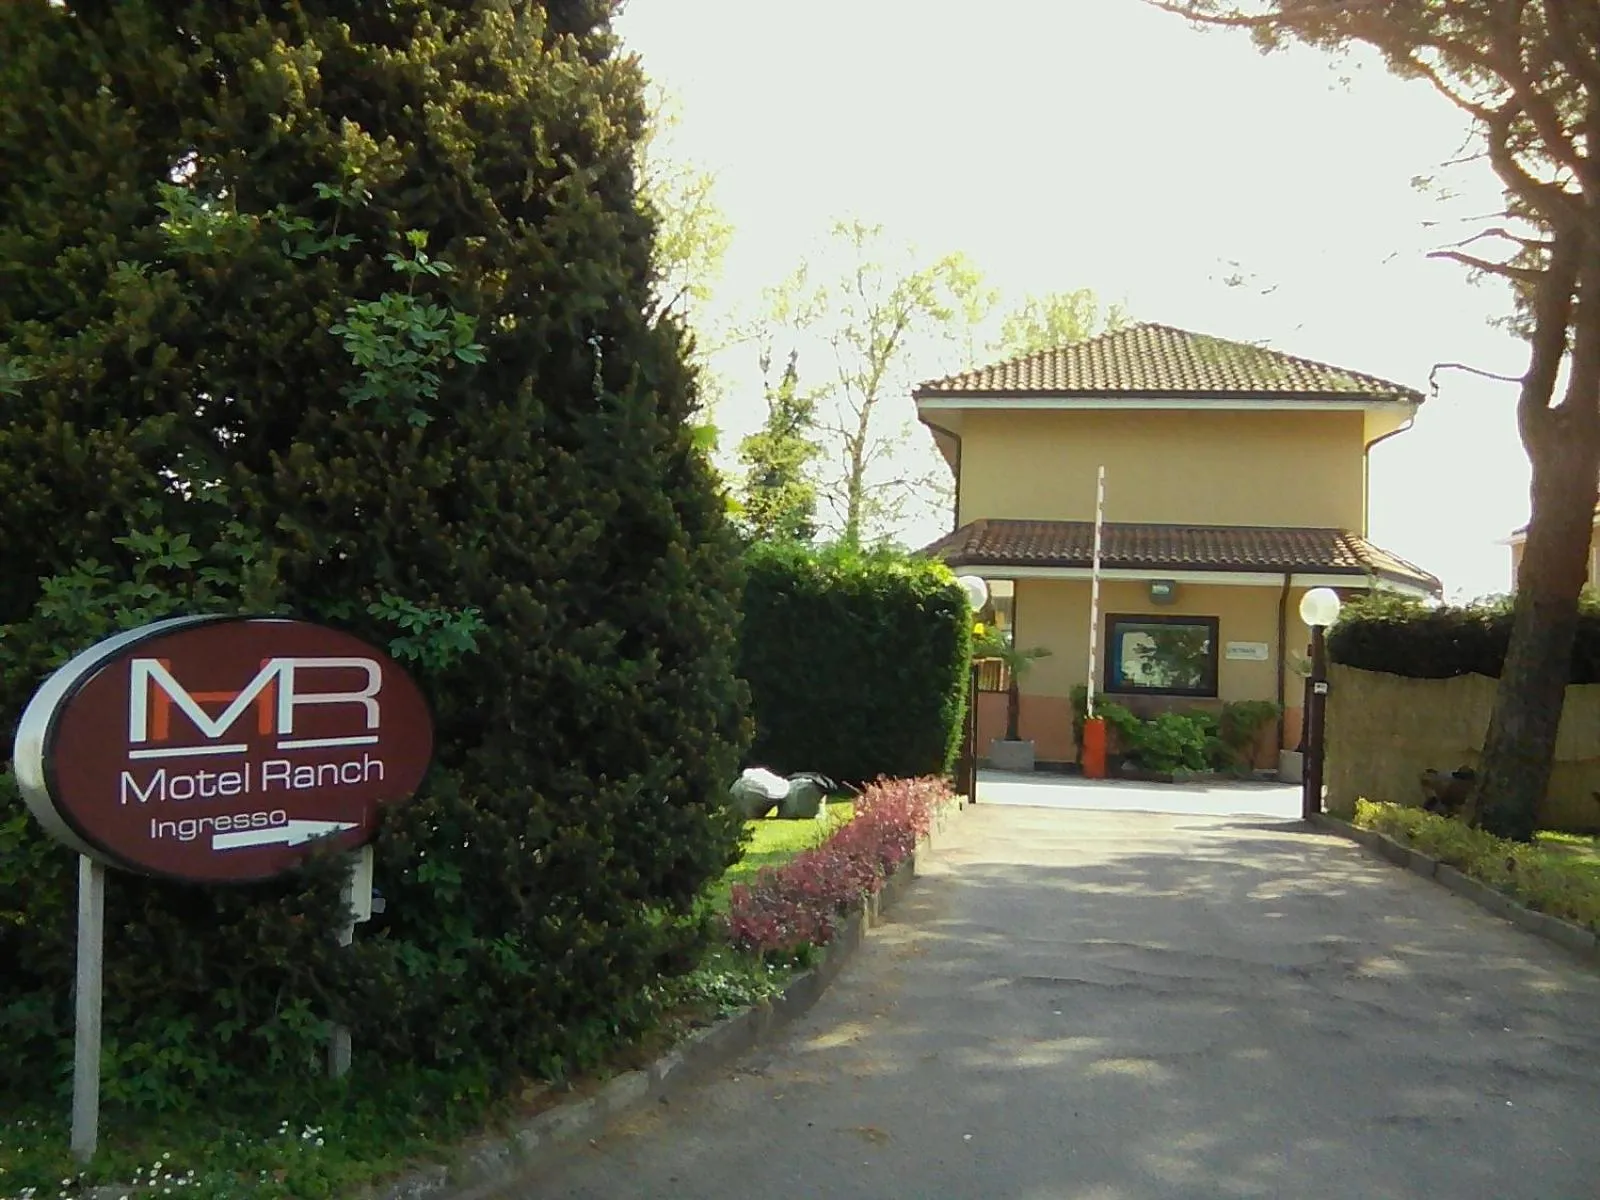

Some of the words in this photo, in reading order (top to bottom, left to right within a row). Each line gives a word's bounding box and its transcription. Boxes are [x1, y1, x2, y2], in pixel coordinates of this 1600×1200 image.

[120, 762, 250, 804] Motel
[262, 753, 384, 792] Ranch
[150, 809, 287, 841] Ingresso
